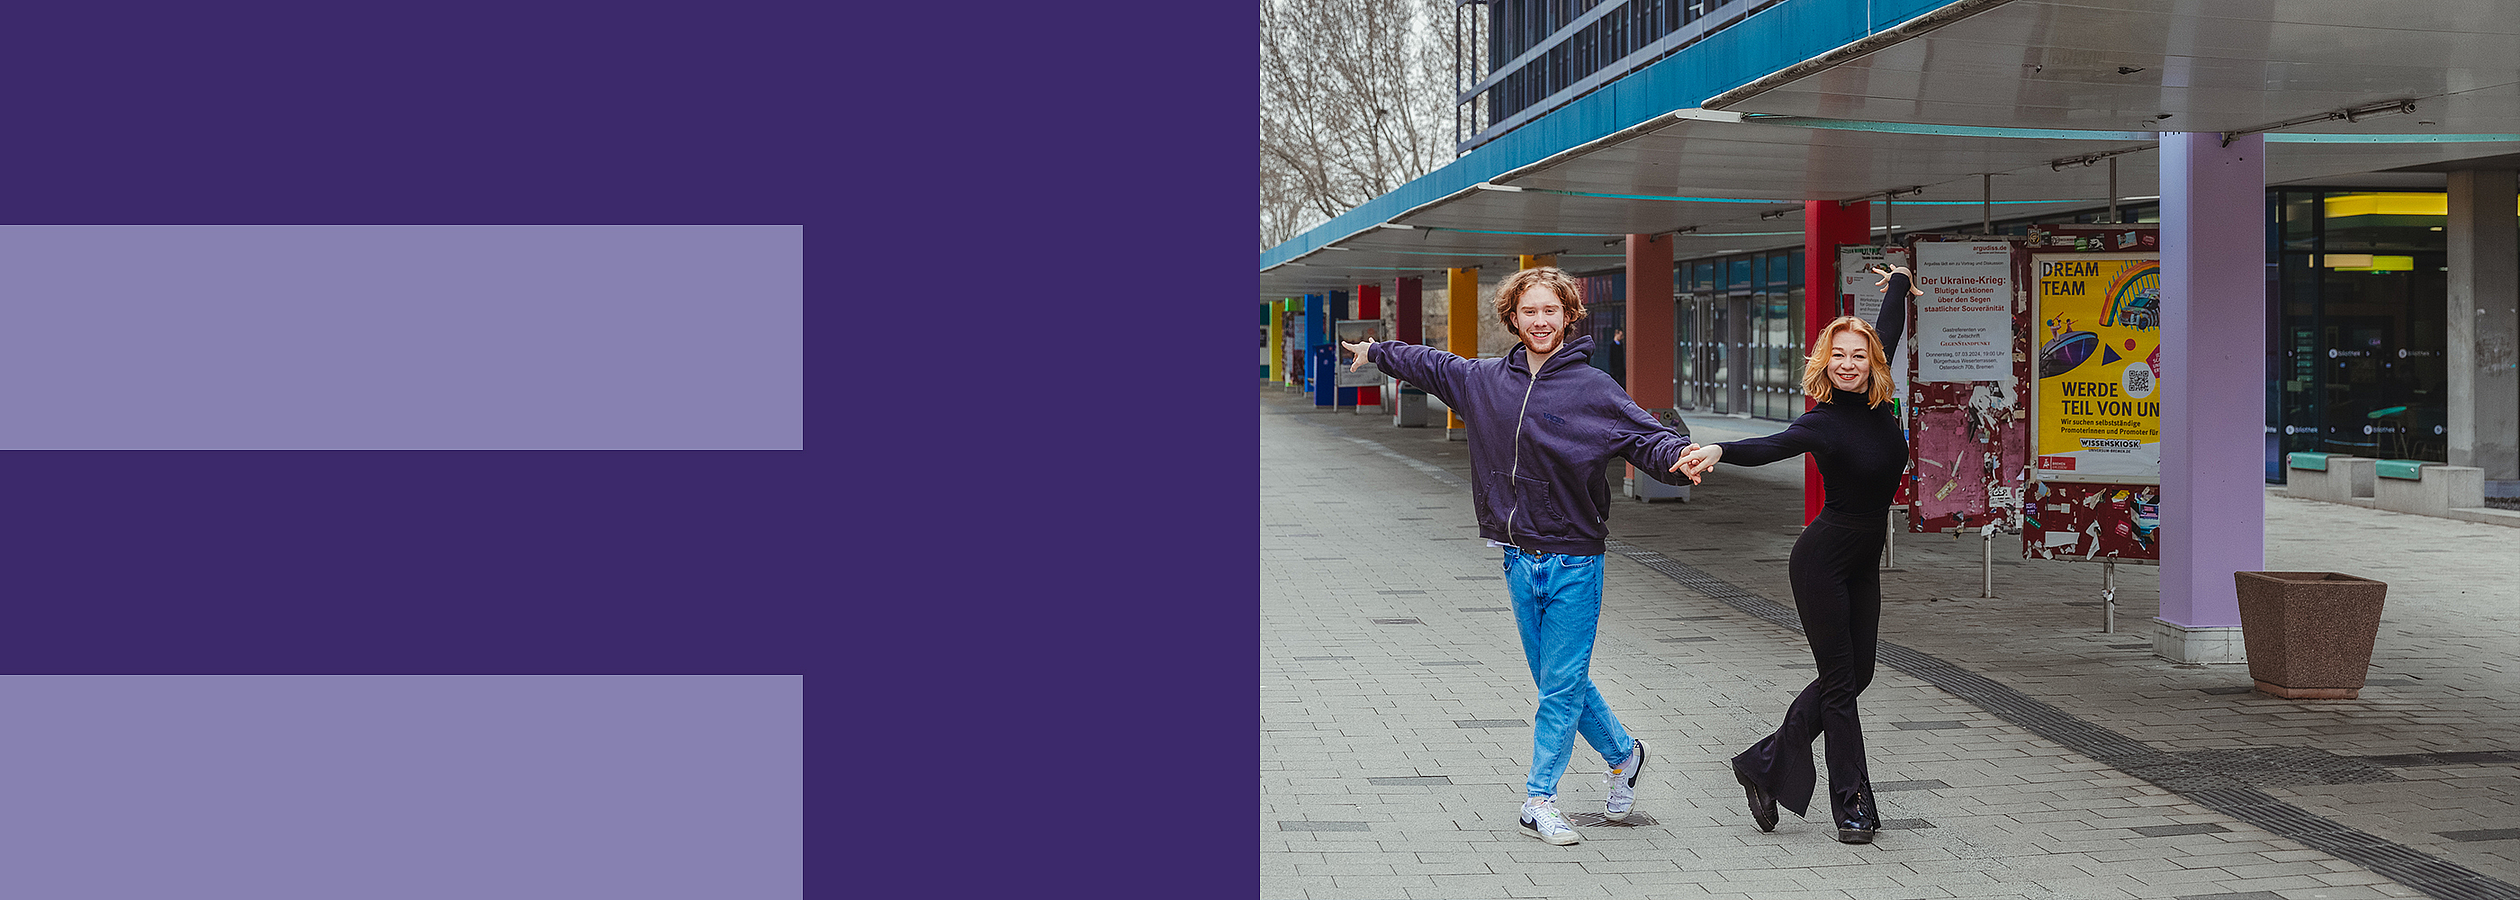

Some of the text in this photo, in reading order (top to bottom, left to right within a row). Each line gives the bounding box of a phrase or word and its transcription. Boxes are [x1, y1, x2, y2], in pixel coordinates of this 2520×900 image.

[2042, 262, 2099, 277] DREAM
[1921, 276, 2006, 286] Der Ukraine-Krieg:
[1934, 287, 1959, 295] Blutige
[2042, 280, 2086, 296] TEAM
[1969, 296, 1991, 304] Segen
[1961, 304, 2005, 312] Souveränität
[2061, 381, 2119, 398] WERDE
[2061, 400, 2160, 417] TEIL VON UN
[2095, 419, 2141, 428] selbstständige
[2081, 439, 2139, 448] WISSENSKIOSK
